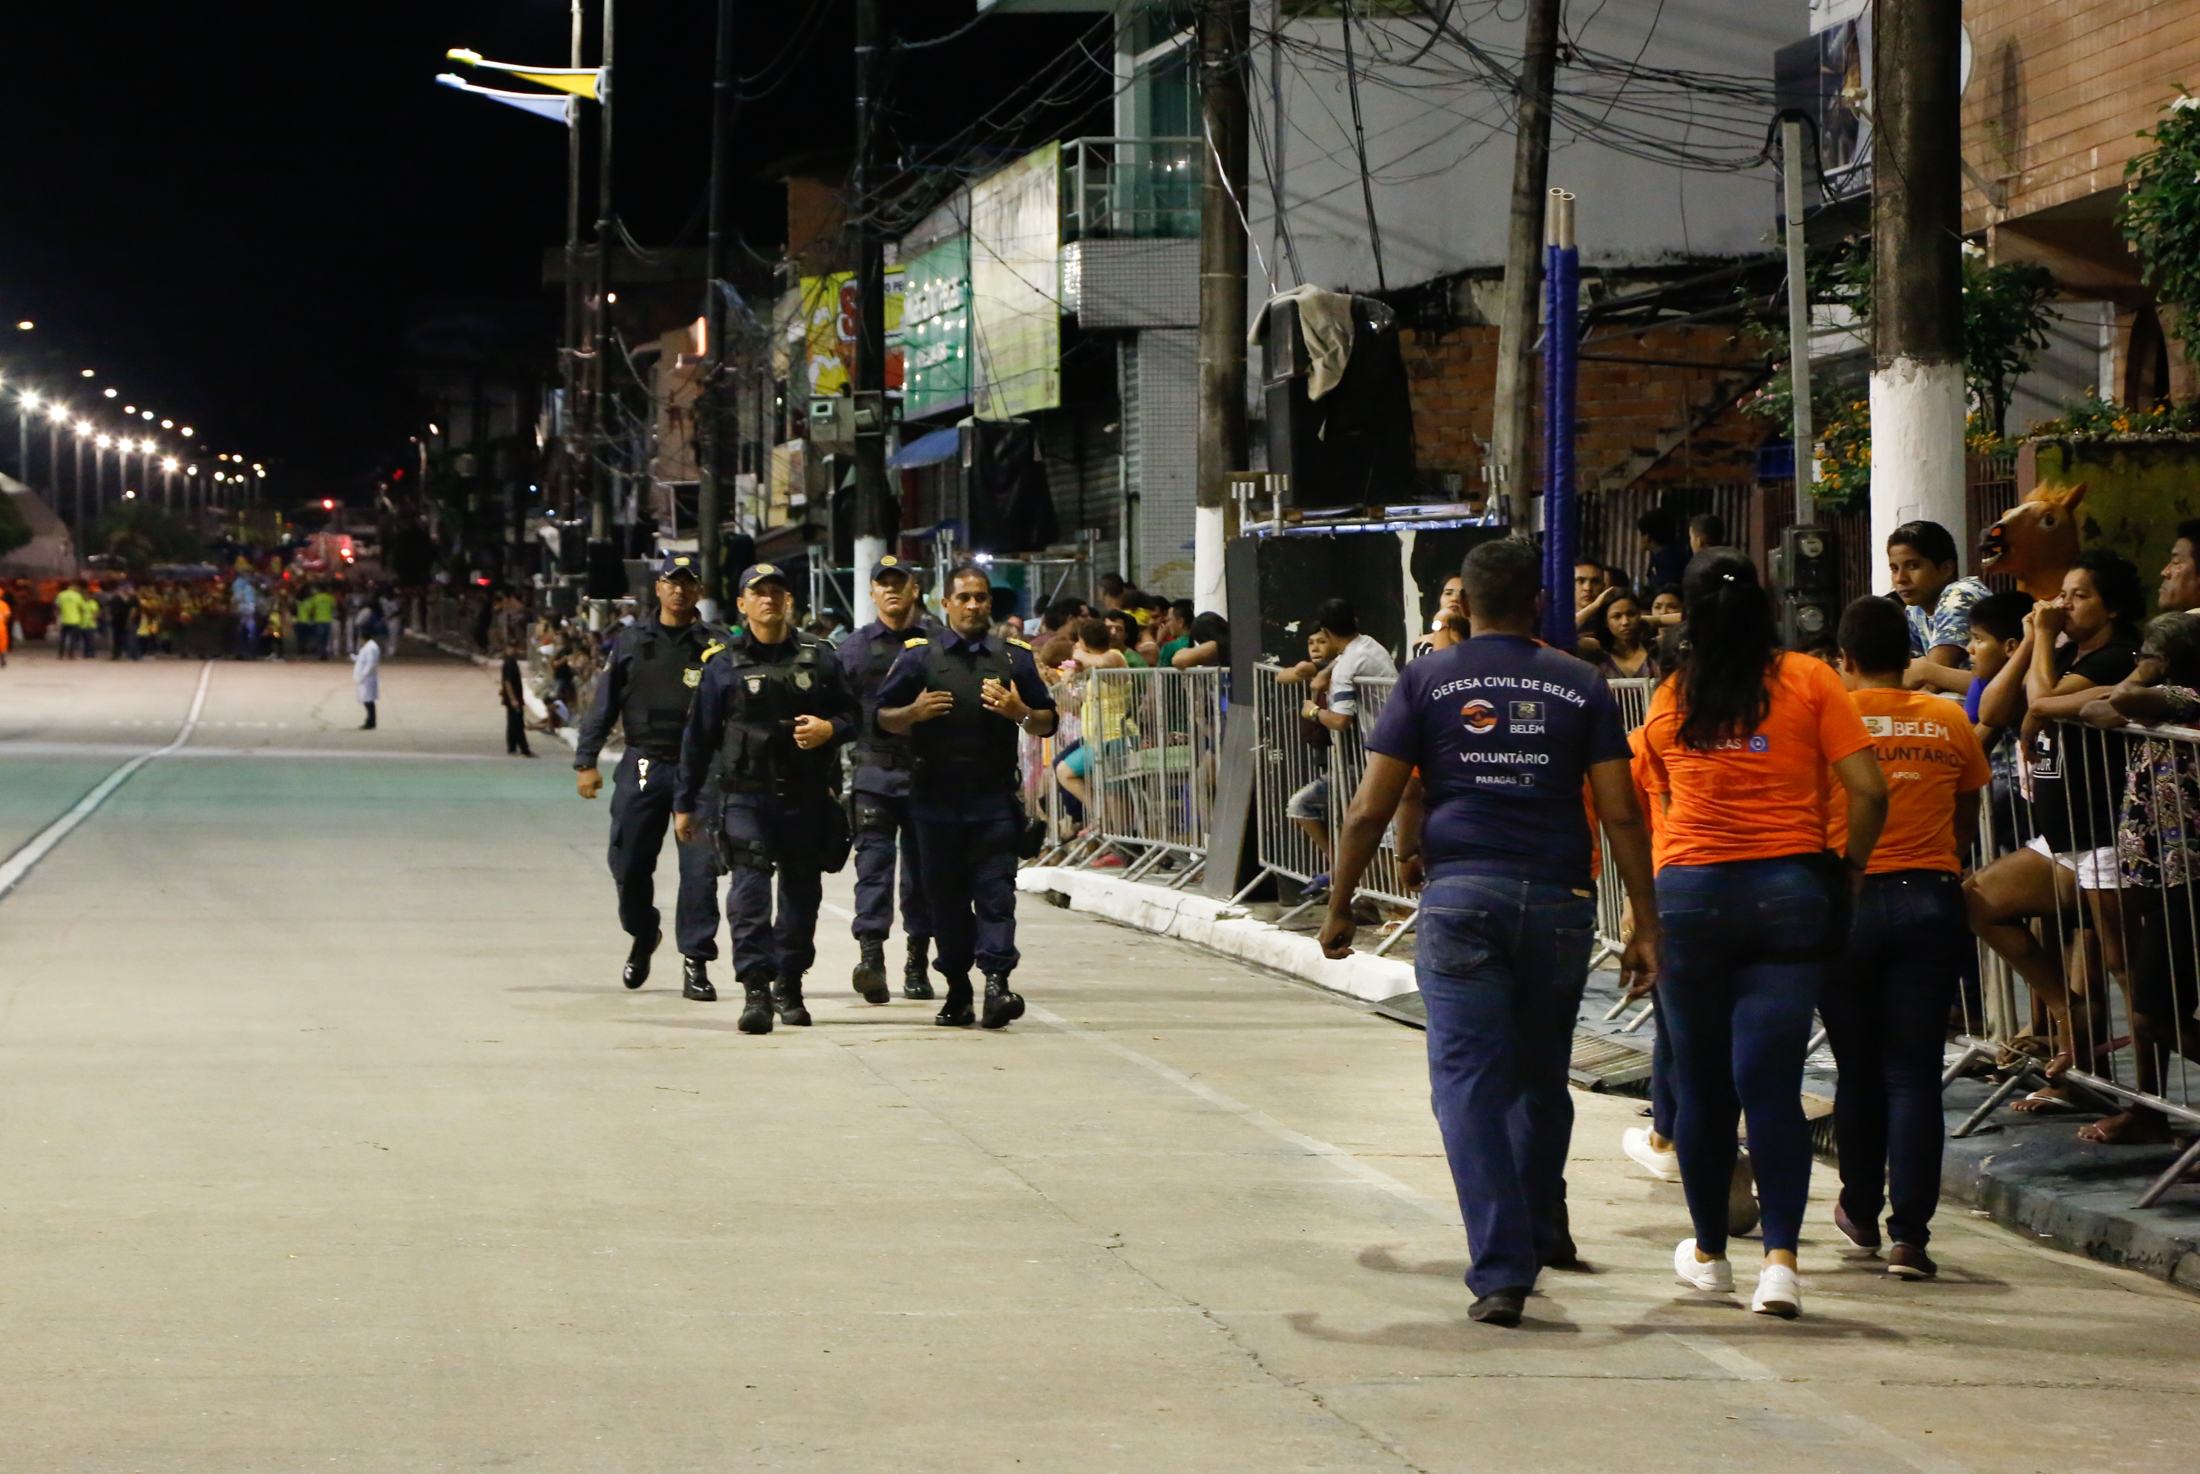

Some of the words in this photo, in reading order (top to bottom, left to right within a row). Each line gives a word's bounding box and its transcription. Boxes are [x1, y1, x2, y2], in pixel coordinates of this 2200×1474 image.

[1431, 678, 1481, 700] DEFESA
[1484, 676, 1518, 688] CIVIL
[1521, 678, 1540, 691] DE
[1542, 682, 1586, 708] BELÉM
[1893, 720, 1950, 741] BELÉM
[1460, 750, 1549, 765] VOLUNTÁRIO
[1875, 744, 1959, 767] LUNTÁRIO
